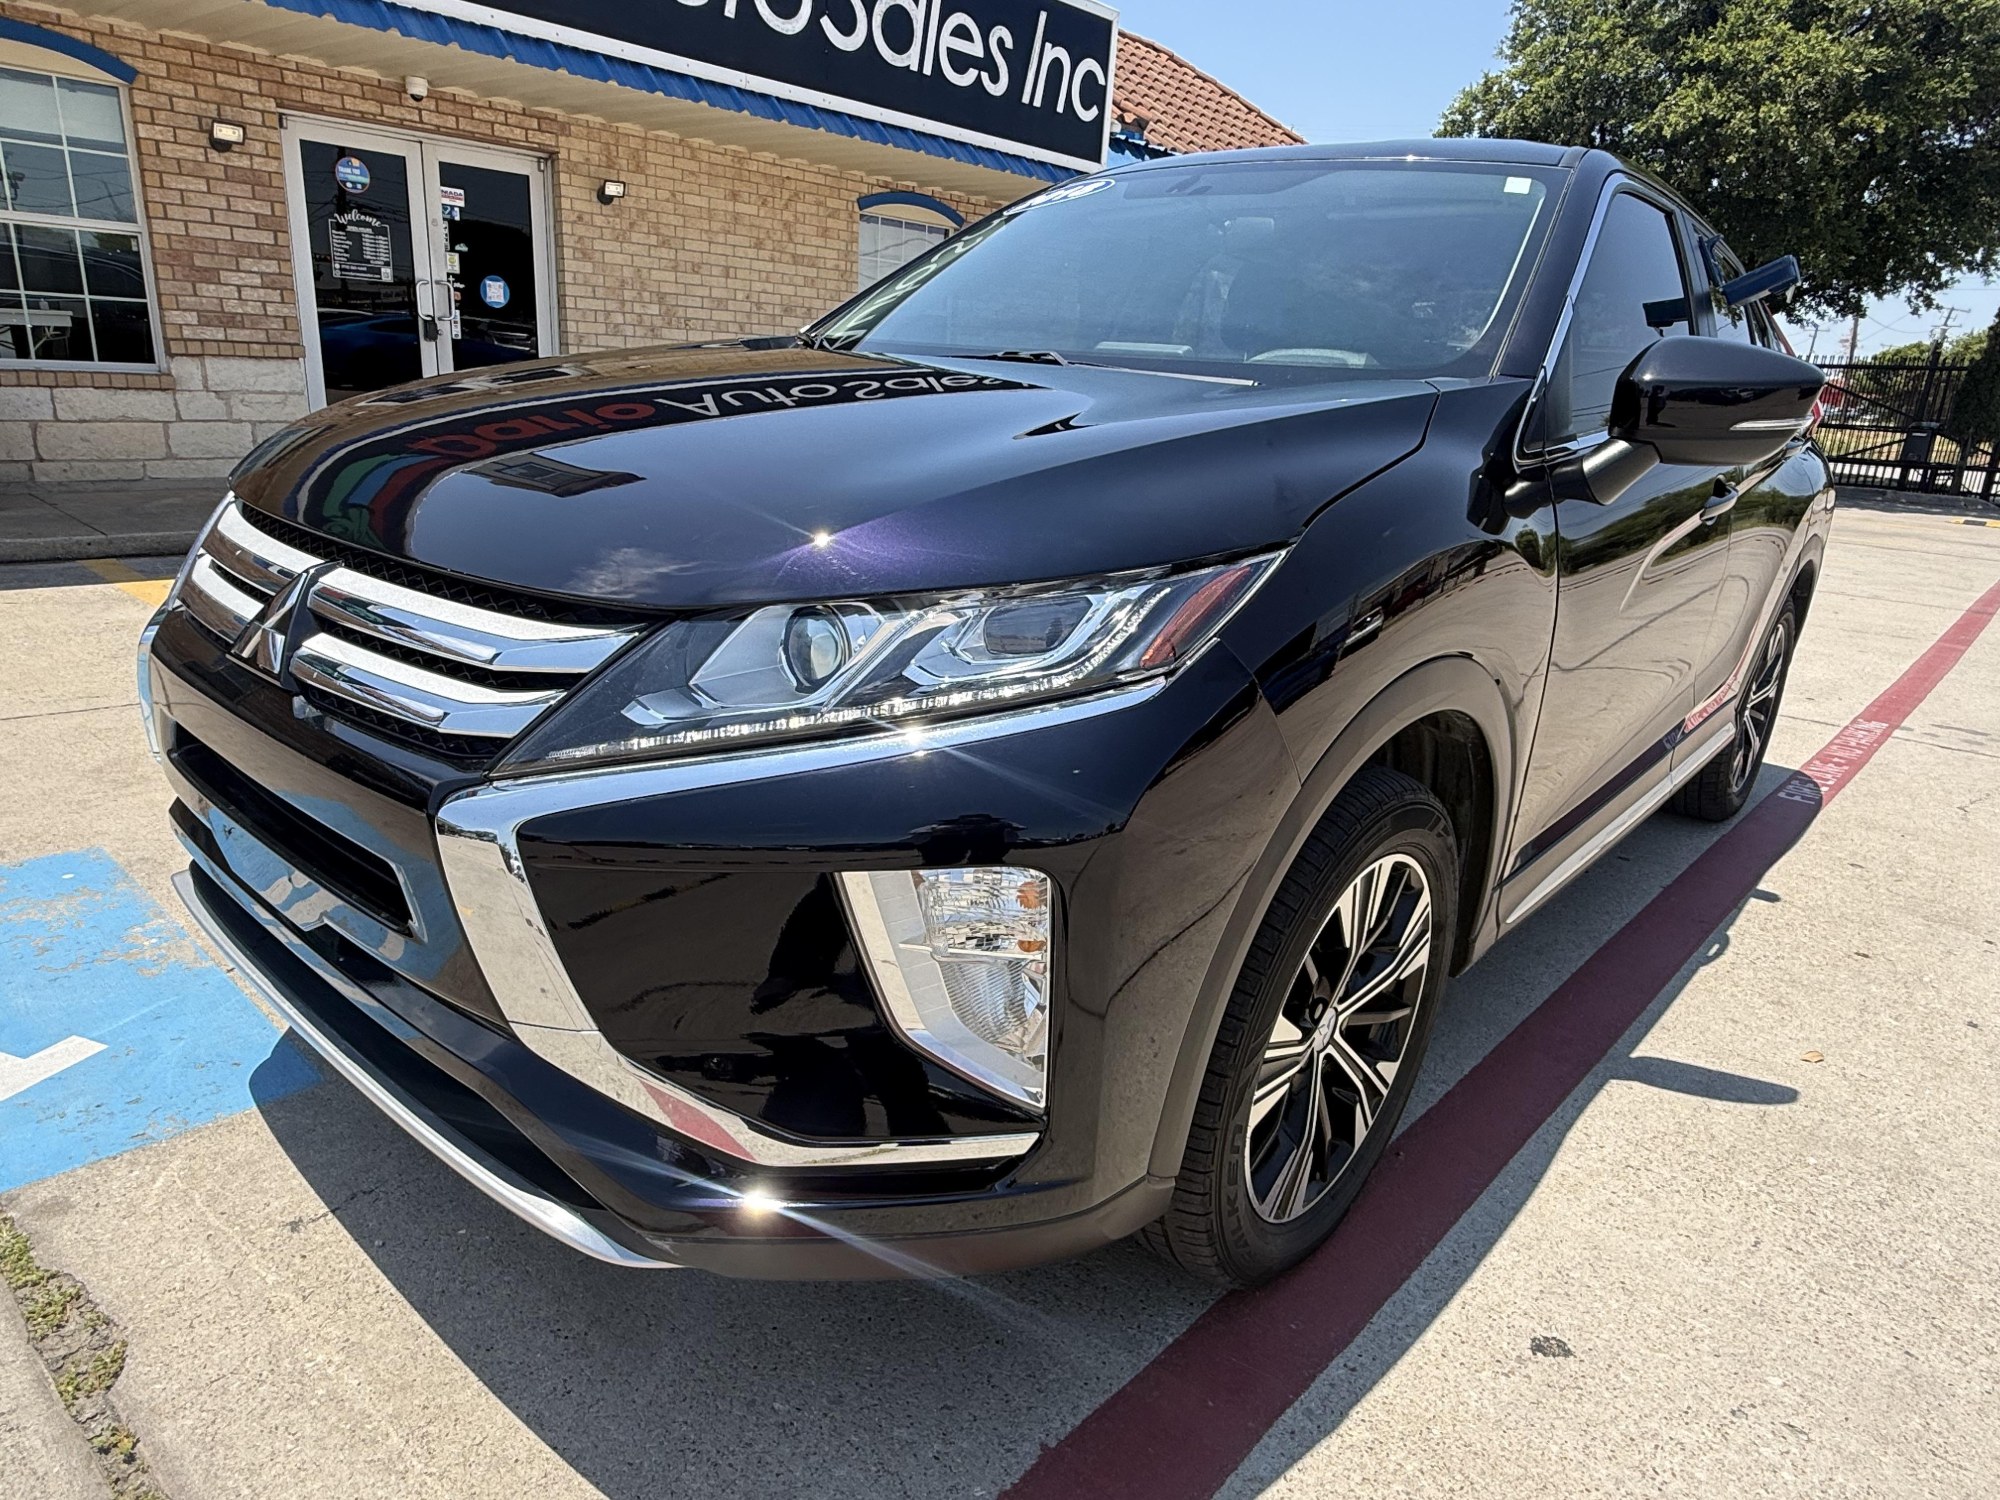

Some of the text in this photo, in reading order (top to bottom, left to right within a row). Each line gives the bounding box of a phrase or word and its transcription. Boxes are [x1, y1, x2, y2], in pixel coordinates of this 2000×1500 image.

[1021, 10, 1106, 123] Inc
[334, 209, 381, 227] Welcome
[1823, 744, 1864, 760] NO
[1797, 760, 1849, 785] LANE
[1777, 778, 1829, 804] FIRE
